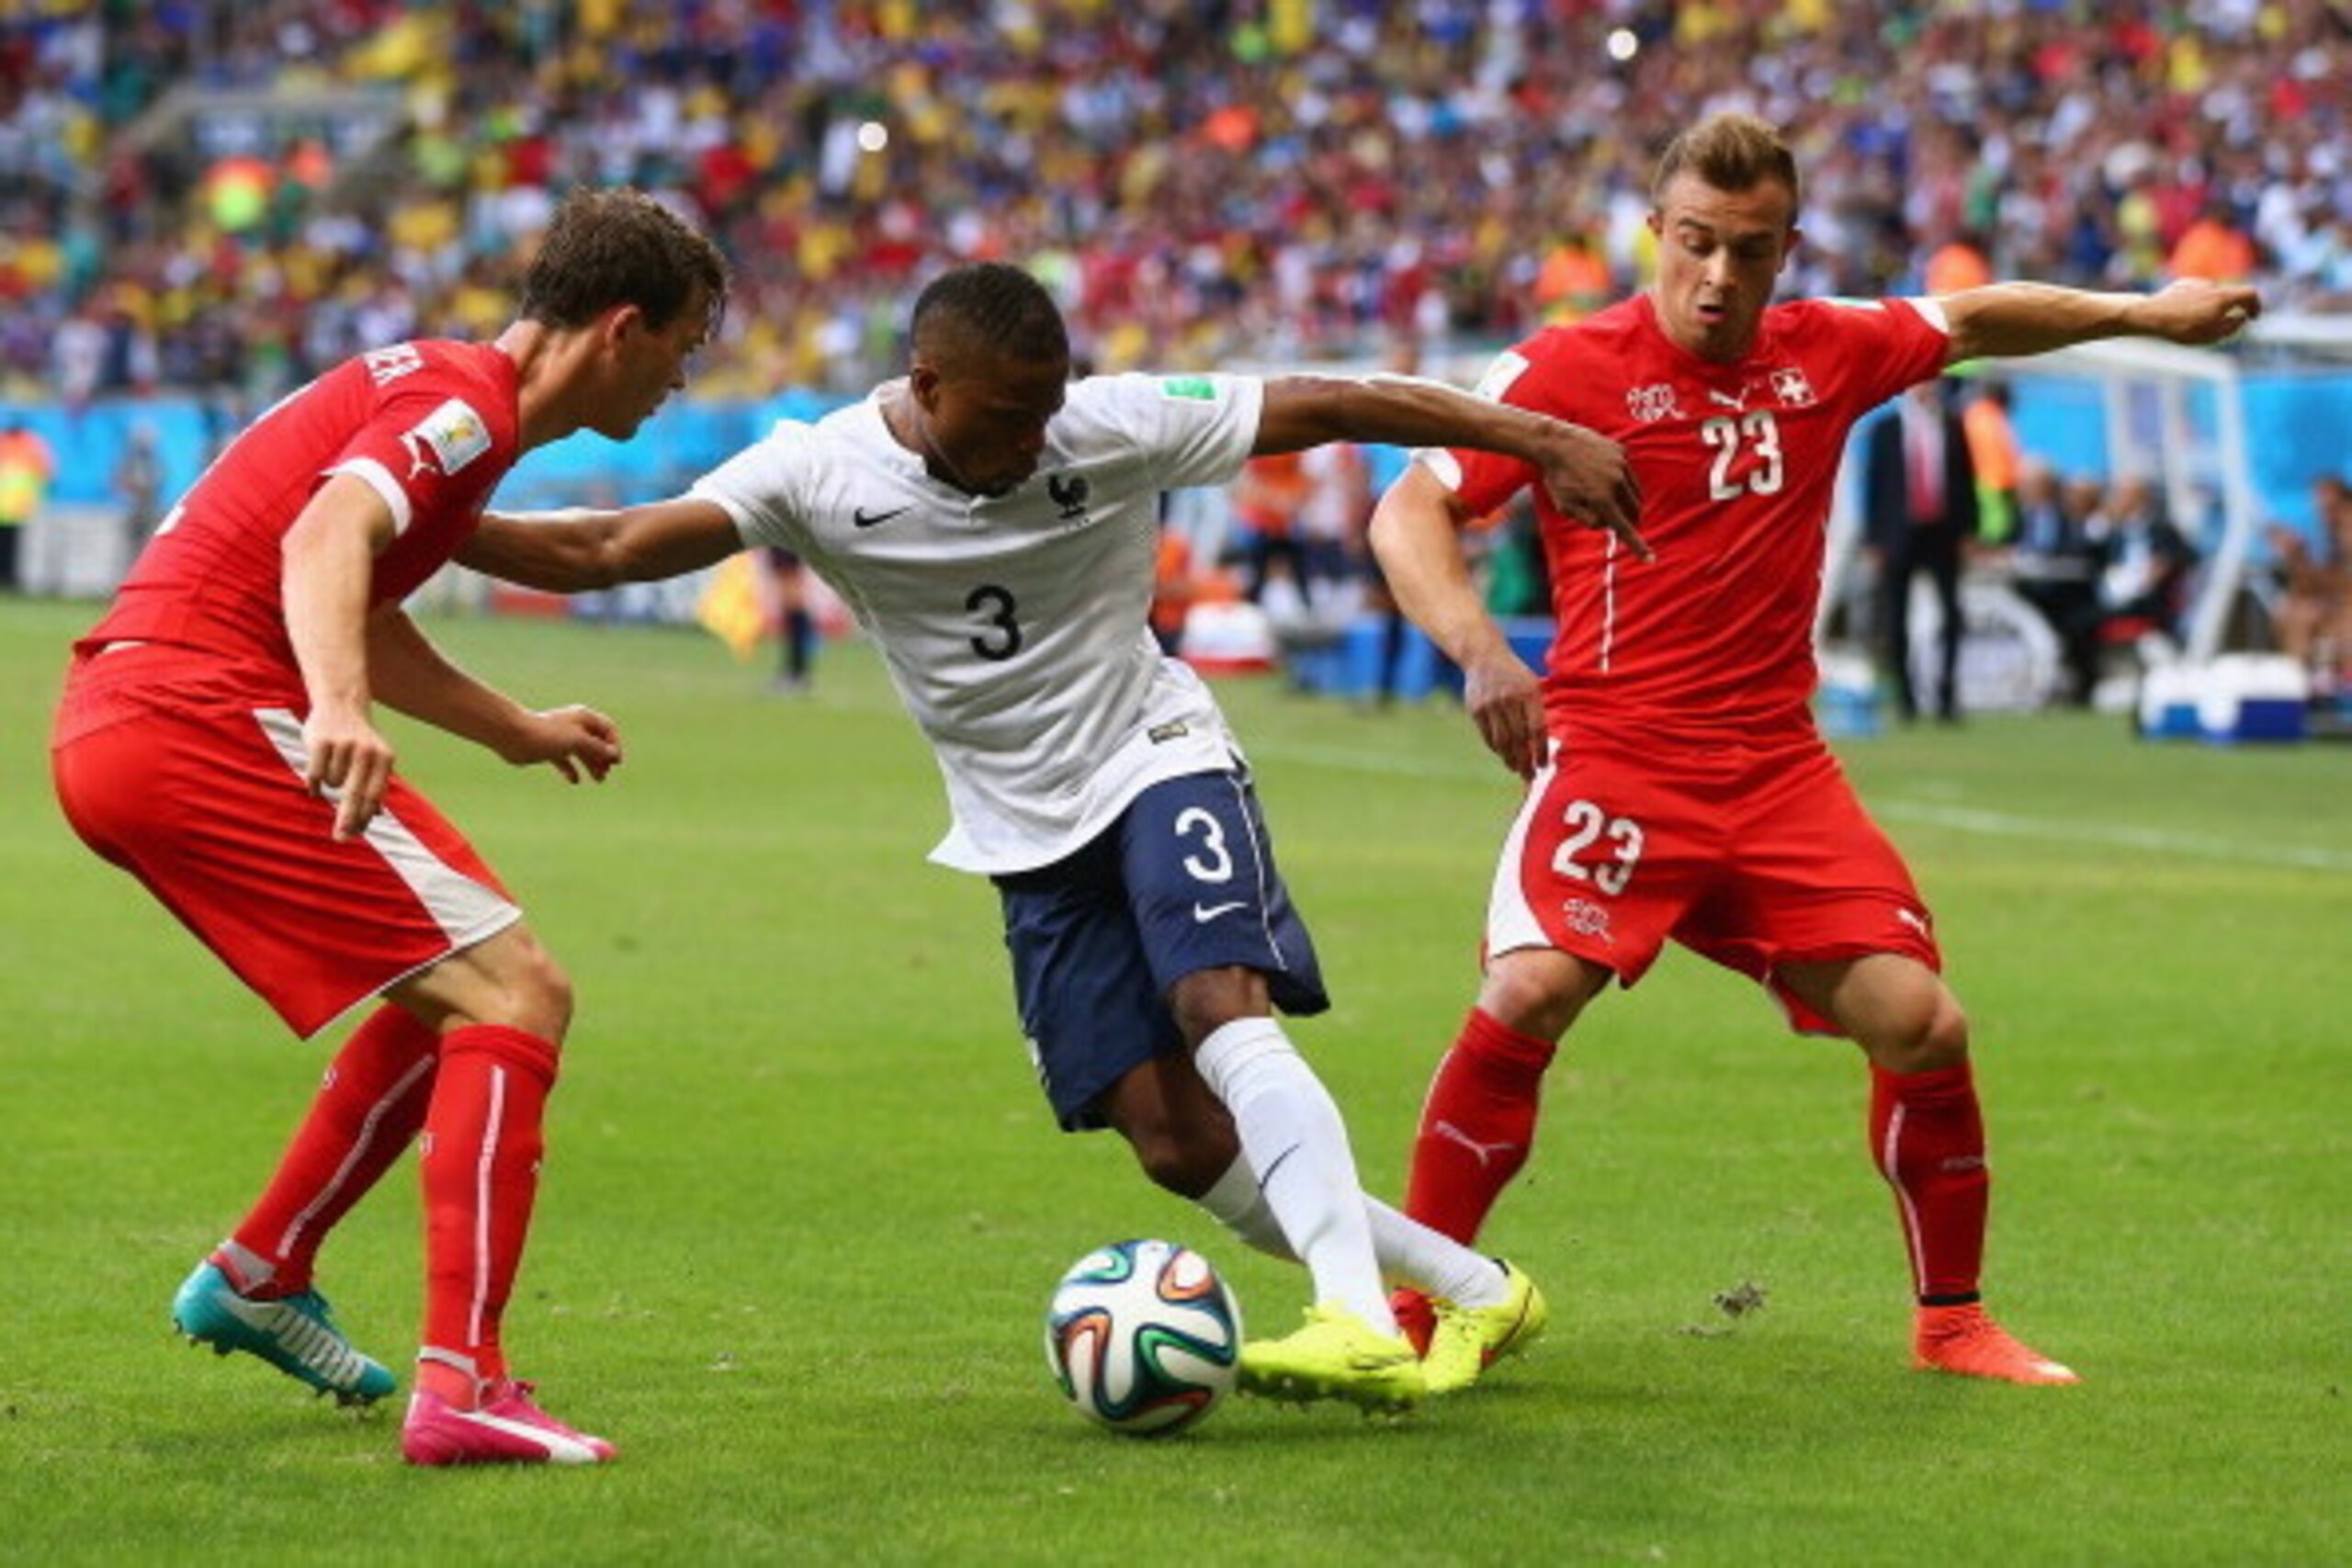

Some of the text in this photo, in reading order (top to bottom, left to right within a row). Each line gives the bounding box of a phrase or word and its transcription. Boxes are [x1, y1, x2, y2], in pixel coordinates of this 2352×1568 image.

[1702, 410, 1782, 500] 23
[966, 585, 1022, 661] 3
[1175, 807, 1233, 883] 3
[1552, 799, 1644, 895] 23
